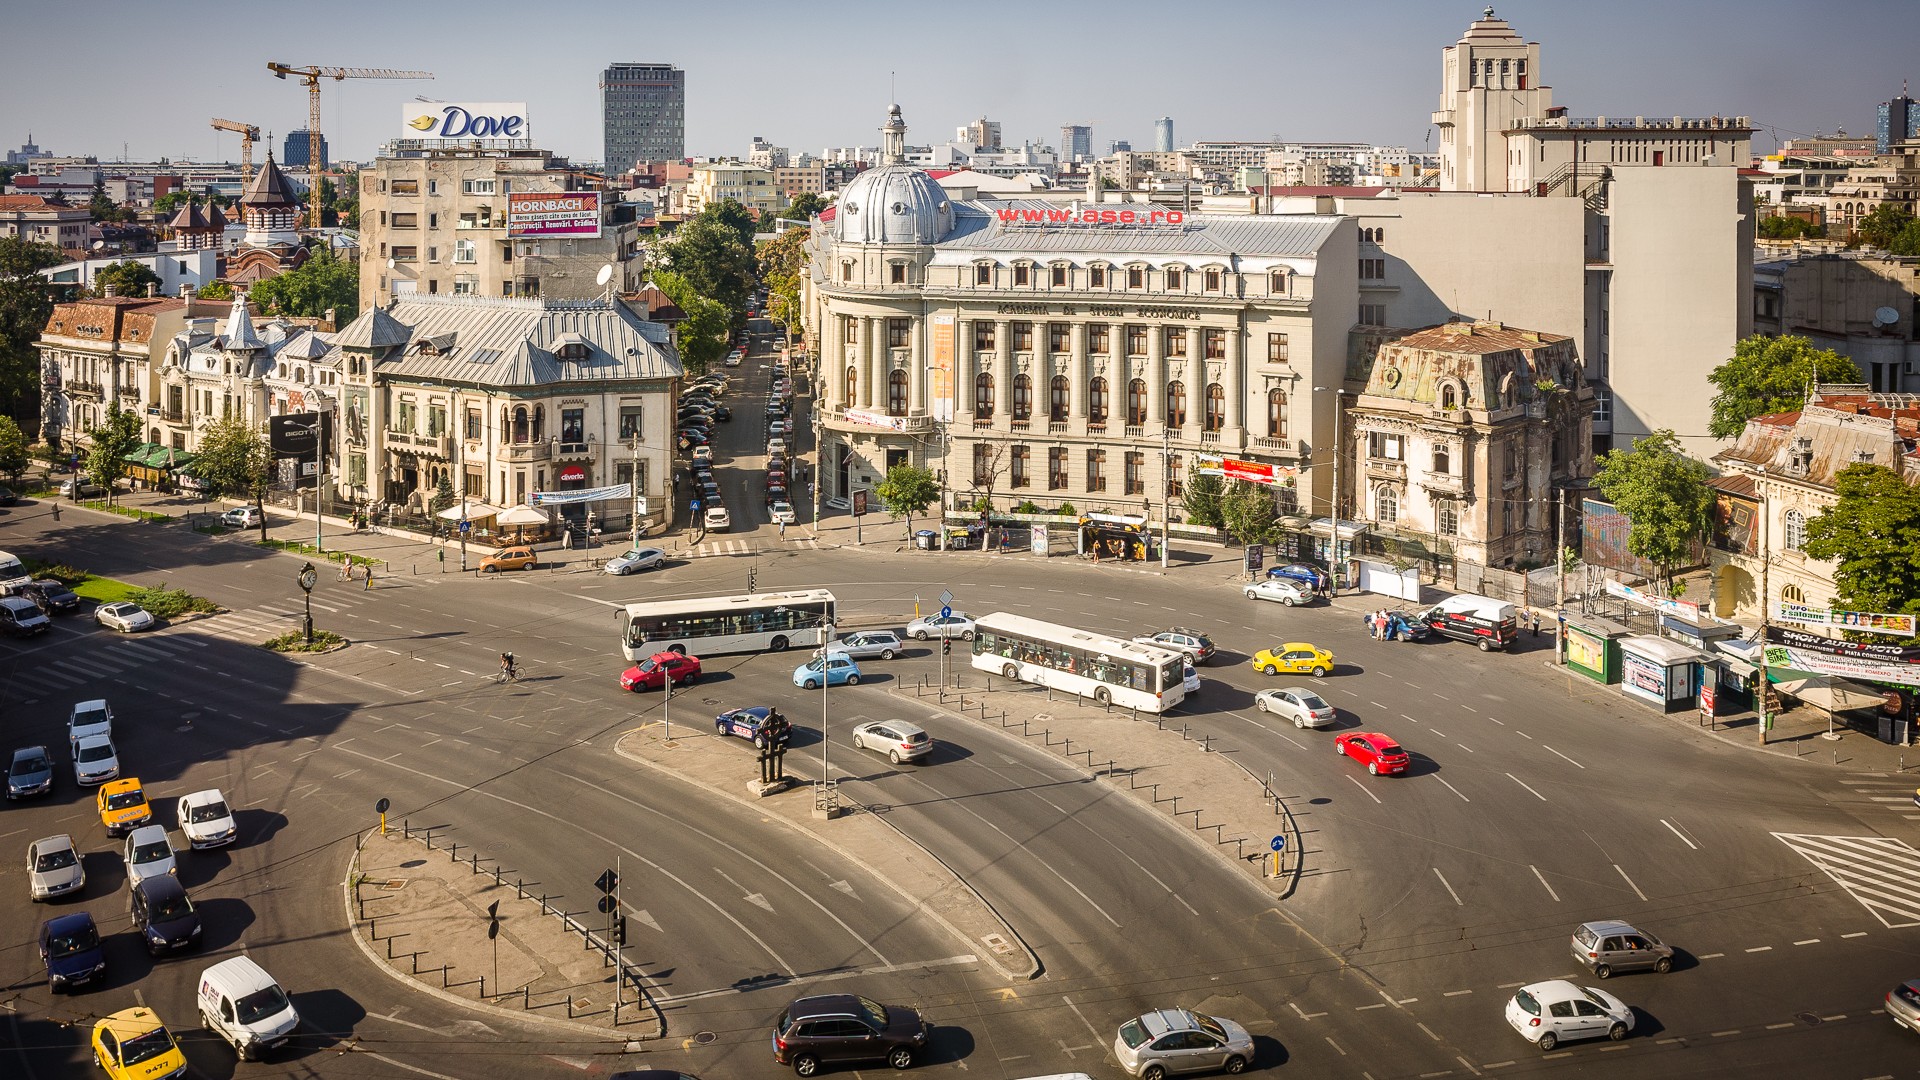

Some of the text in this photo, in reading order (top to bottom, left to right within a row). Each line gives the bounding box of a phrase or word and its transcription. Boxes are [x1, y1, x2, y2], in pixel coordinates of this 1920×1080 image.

[440, 106, 525, 137] Dove
[511, 199, 582, 212] HORNBACH
[997, 209, 1184, 224] www.ase.ro
[997, 304, 1201, 321] ACADEMIA DE STUDII ECONOMICE
[1782, 631, 1904, 655] SHOW AUTO MOTO
[1802, 643, 1835, 653] SEPTEMBRIE
[1765, 648, 1785, 657] BIFE
[145, 1061, 169, 1075] 9477
